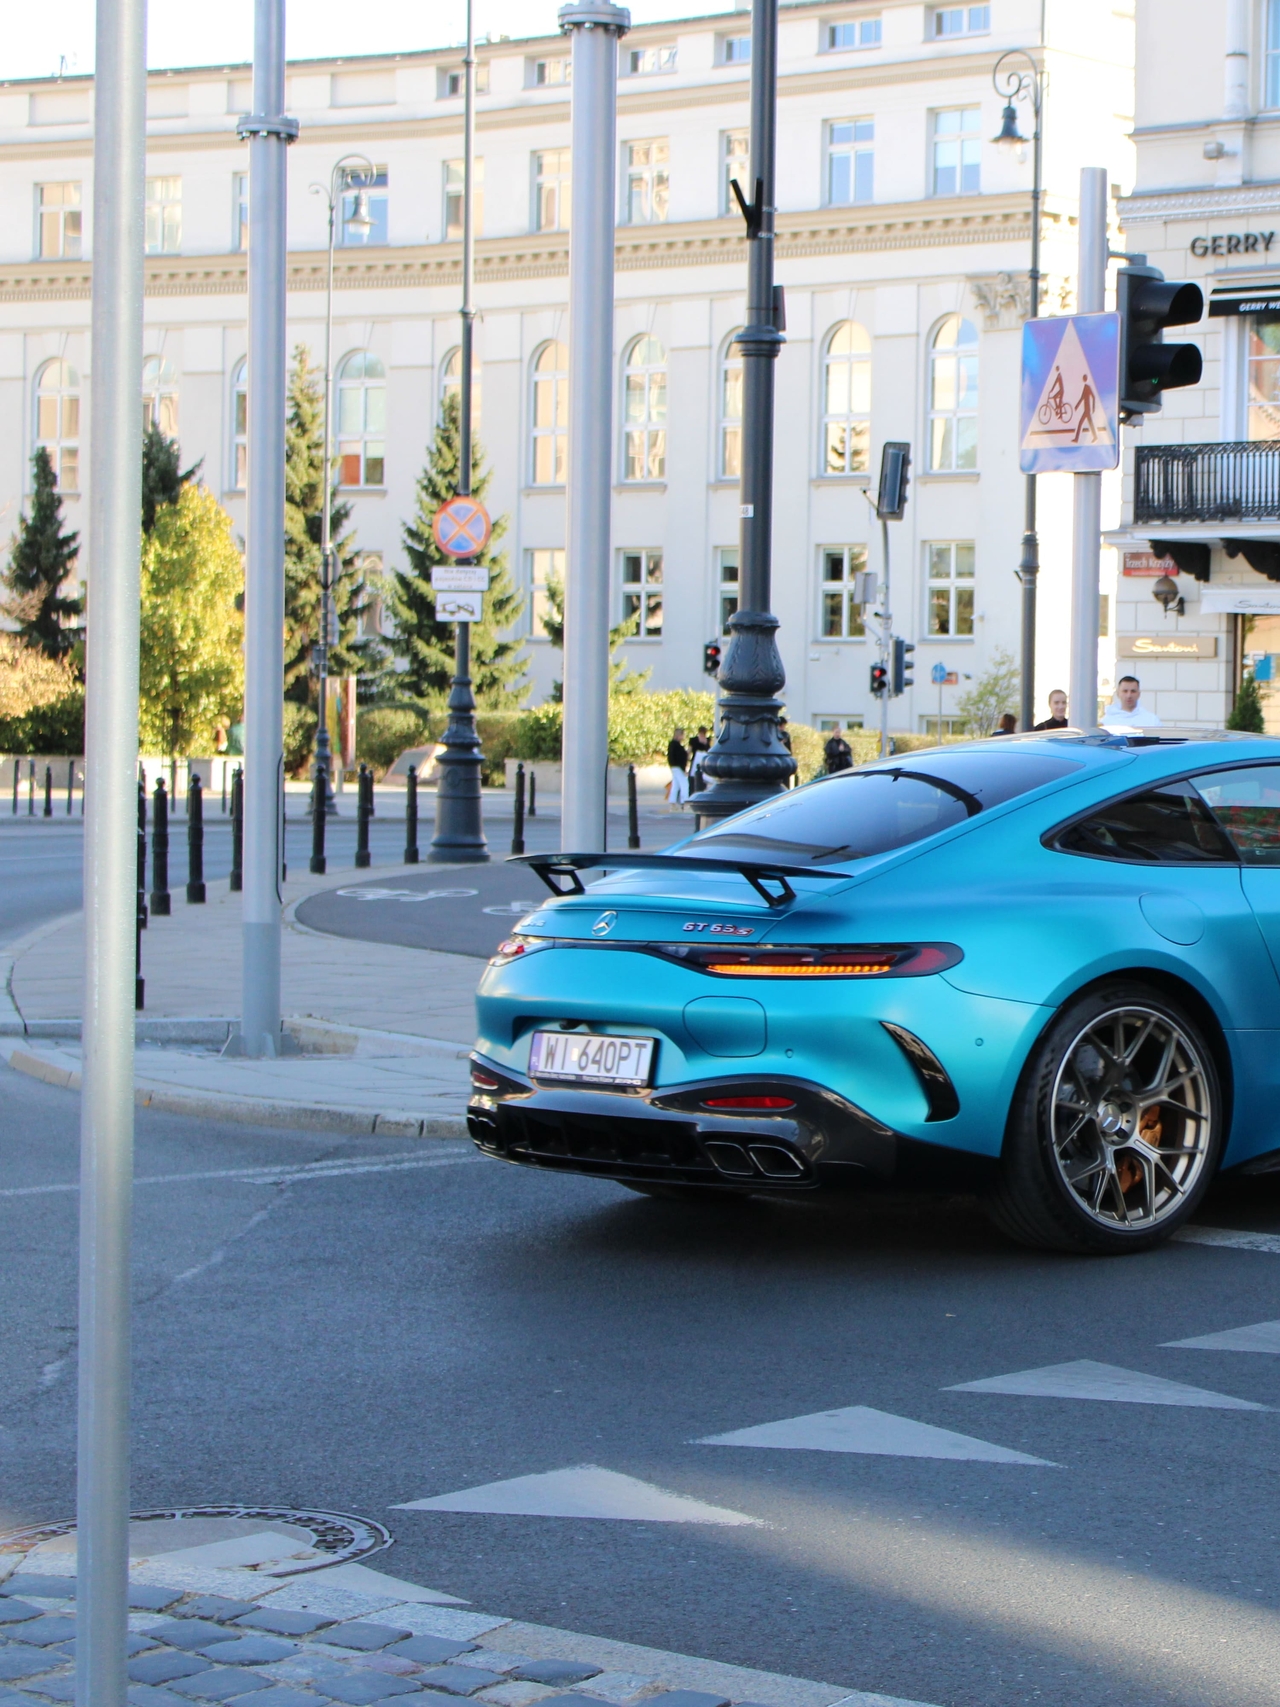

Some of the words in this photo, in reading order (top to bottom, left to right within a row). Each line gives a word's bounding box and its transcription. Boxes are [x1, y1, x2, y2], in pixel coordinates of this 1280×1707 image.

[1191, 231, 1275, 258] GERRY
[1239, 302, 1266, 312] GERRY
[1125, 557, 1147, 569] Trzech
[1132, 638, 1199, 653] Santoni
[683, 922, 708, 932] GT
[710, 923, 734, 934] 63
[544, 1036, 569, 1070] WI
[577, 1039, 647, 1076] 640PT
